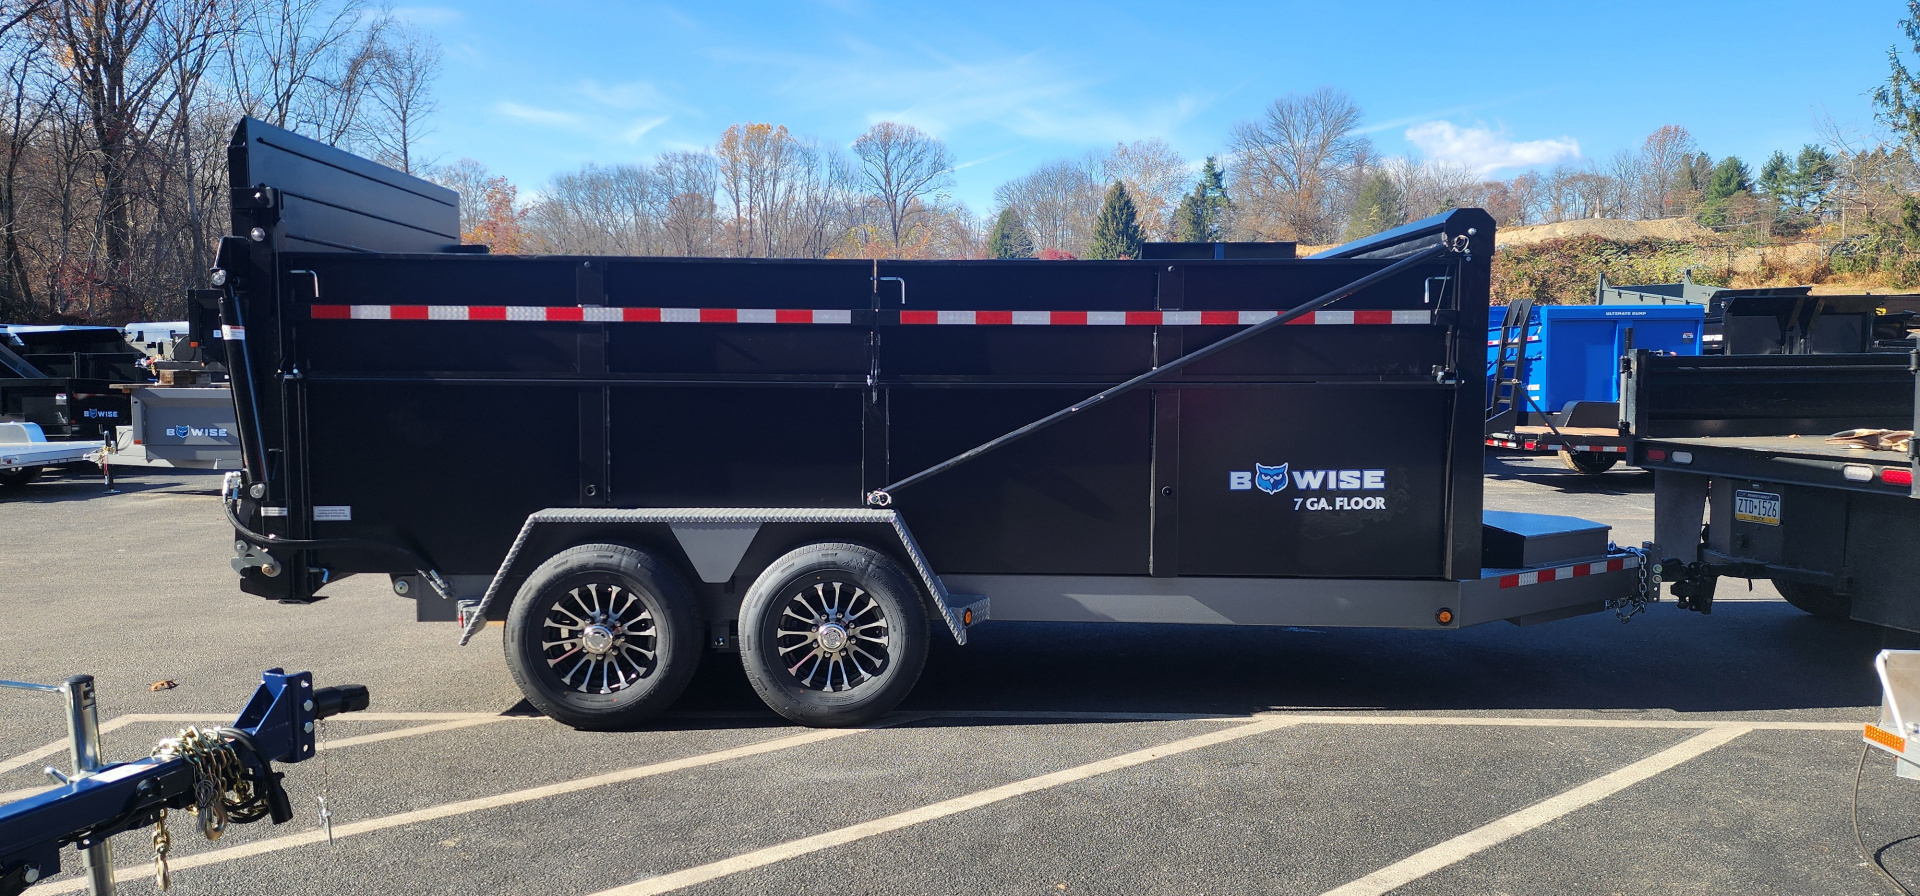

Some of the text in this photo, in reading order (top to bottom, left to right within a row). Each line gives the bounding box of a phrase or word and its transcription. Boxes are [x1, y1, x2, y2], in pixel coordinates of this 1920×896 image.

[1293, 496, 1387, 511] 7 GA. FLOOR
